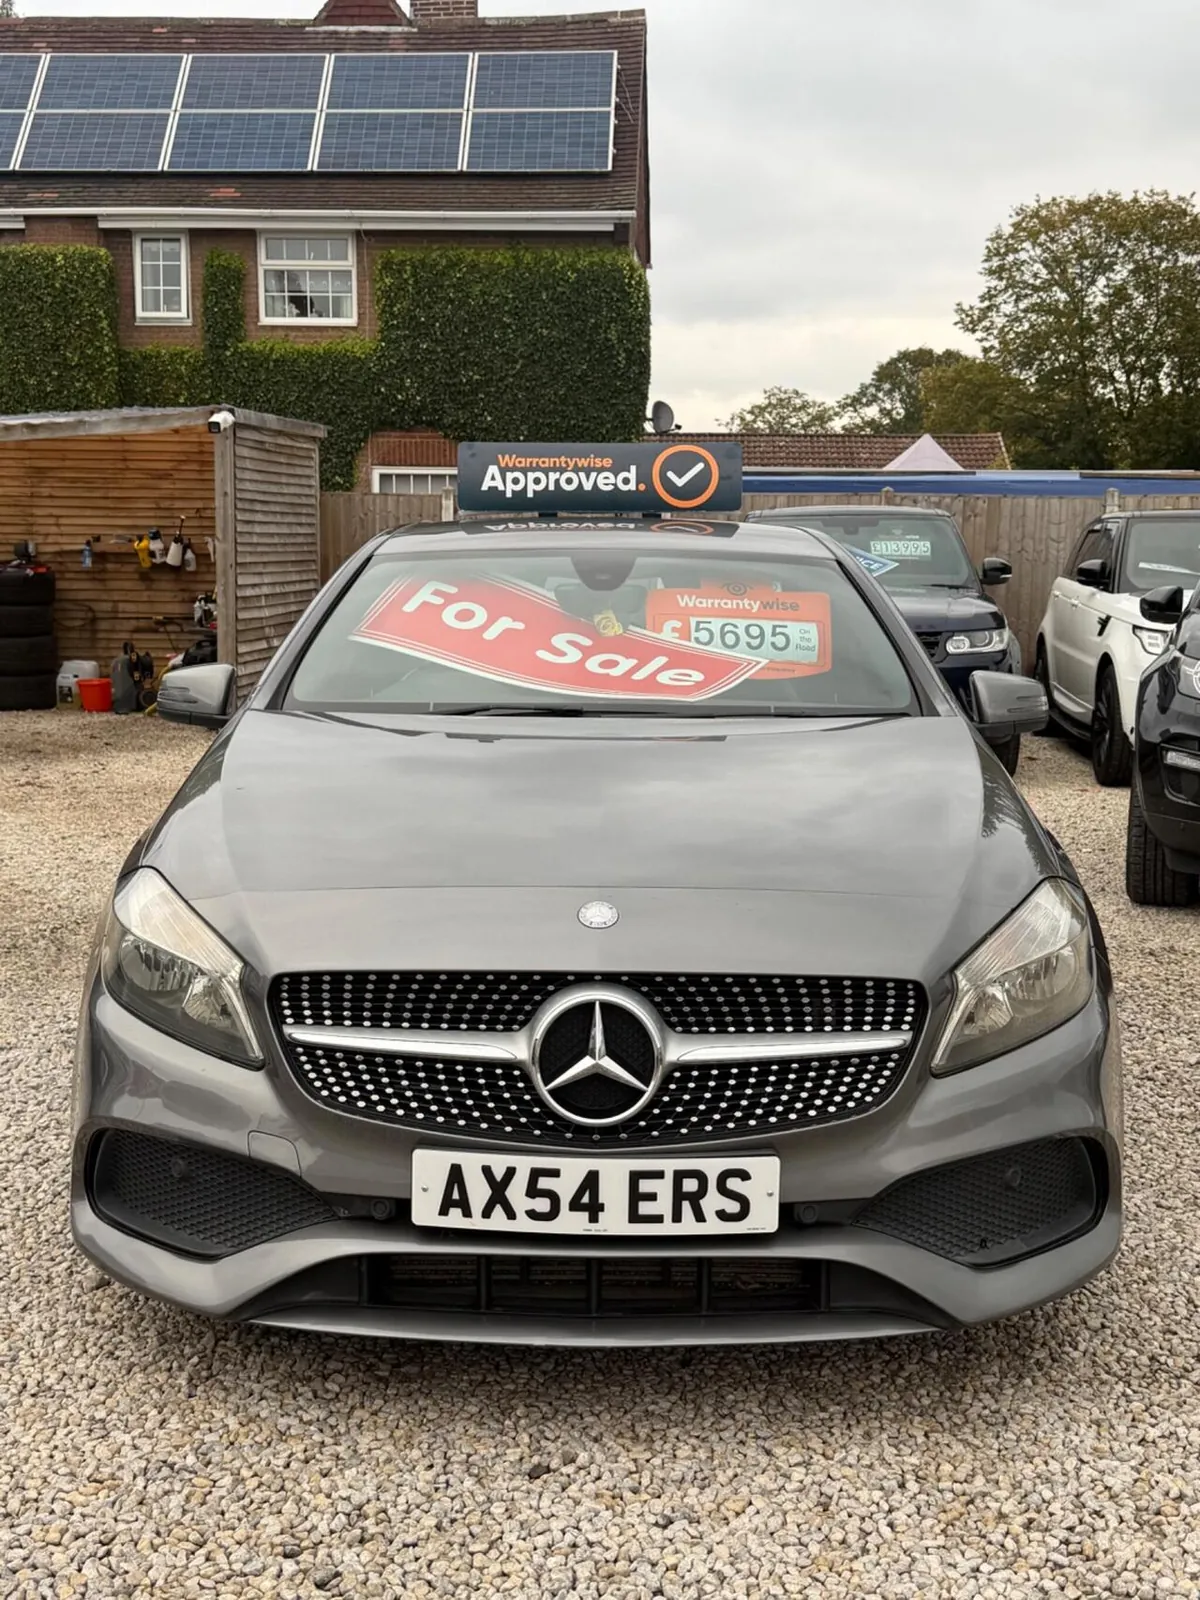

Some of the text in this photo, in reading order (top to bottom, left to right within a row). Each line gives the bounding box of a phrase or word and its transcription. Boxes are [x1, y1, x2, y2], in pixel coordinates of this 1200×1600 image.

[498, 454, 613, 470] Warrantywise
[480, 465, 646, 498] Approved.
[872, 542, 930, 554] £13995
[677, 594, 800, 613] Warrantywise
[402, 580, 705, 687] For Sale
[795, 643, 816, 652] Road
[438, 1163, 752, 1224] AX54 ERS
